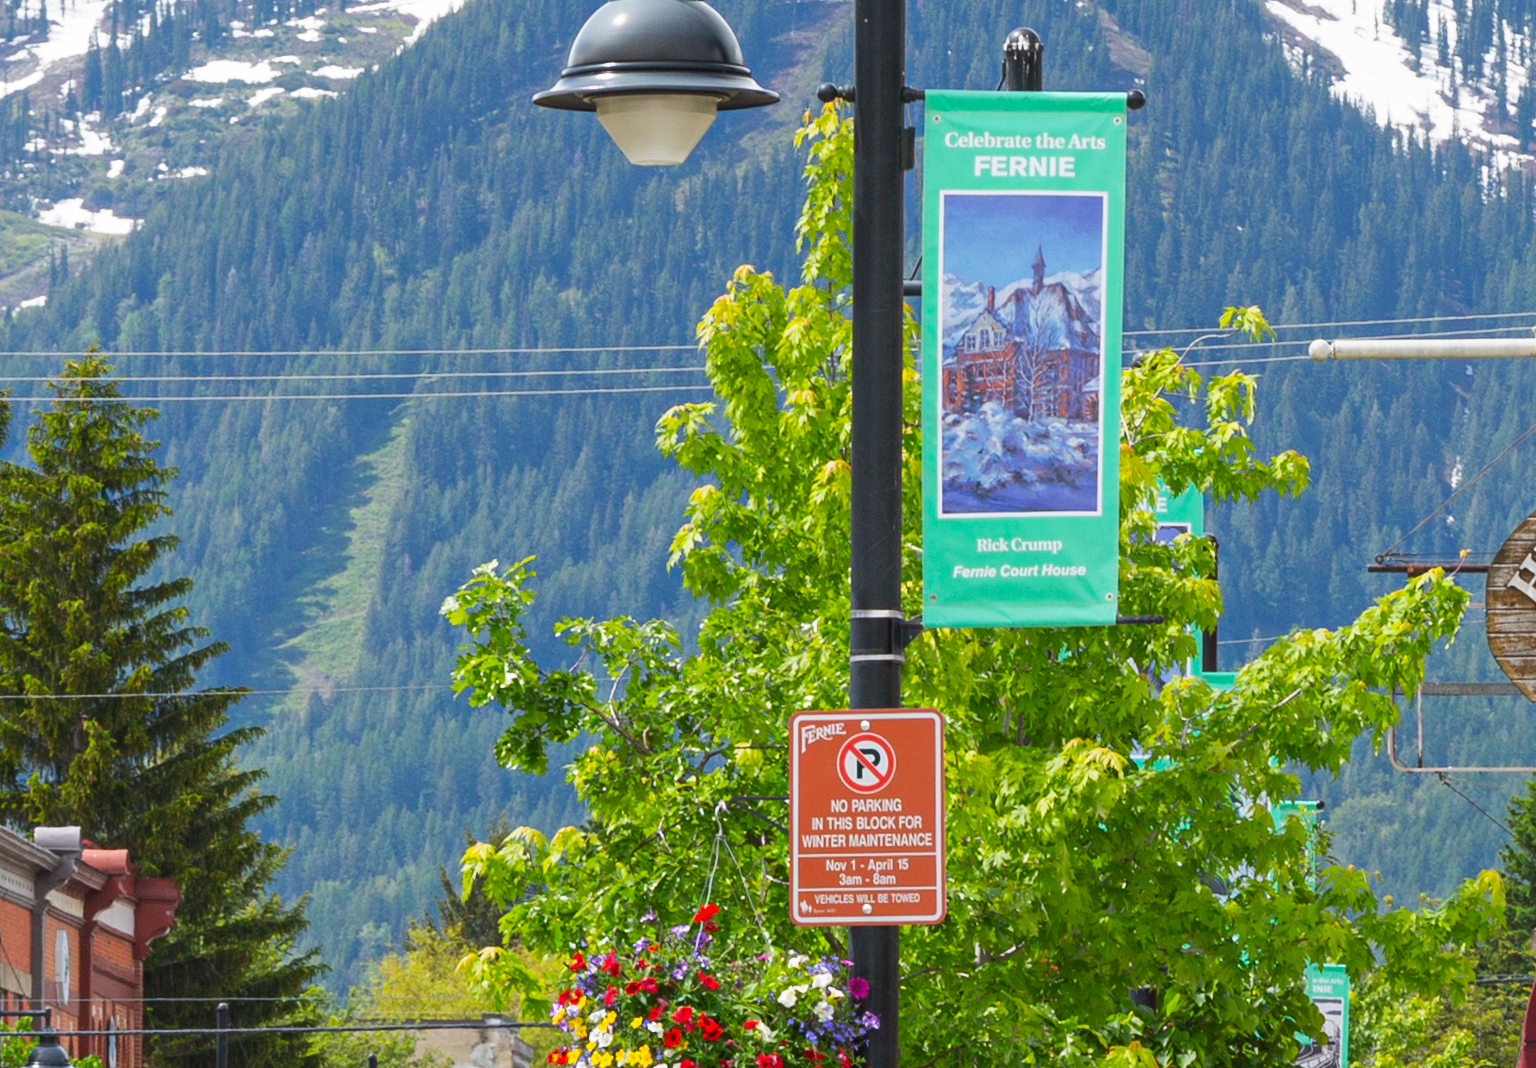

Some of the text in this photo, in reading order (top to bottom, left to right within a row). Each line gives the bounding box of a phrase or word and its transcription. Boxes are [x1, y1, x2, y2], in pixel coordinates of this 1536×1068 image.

[944, 131, 1106, 150] Celebrate the Arts
[973, 155, 1076, 178] FERNIE
[976, 537, 1063, 554] Rick Crump
[952, 563, 1087, 578] Fernie Court House
[801, 722, 847, 754] FERNIE
[830, 798, 902, 813] NO PARKING
[811, 815, 923, 831] IN THIS BLOCK FOR
[801, 832, 933, 848] WINTER MAINTENANCE
[825, 859, 847, 872] Nov
[851, 859, 857, 871] 1
[867, 858, 894, 873] April
[897, 858, 910, 870] 15
[839, 874, 862, 886] 3am
[872, 873, 897, 885] 8am
[814, 892, 921, 905] VEHICLES WILL BE TOWED
